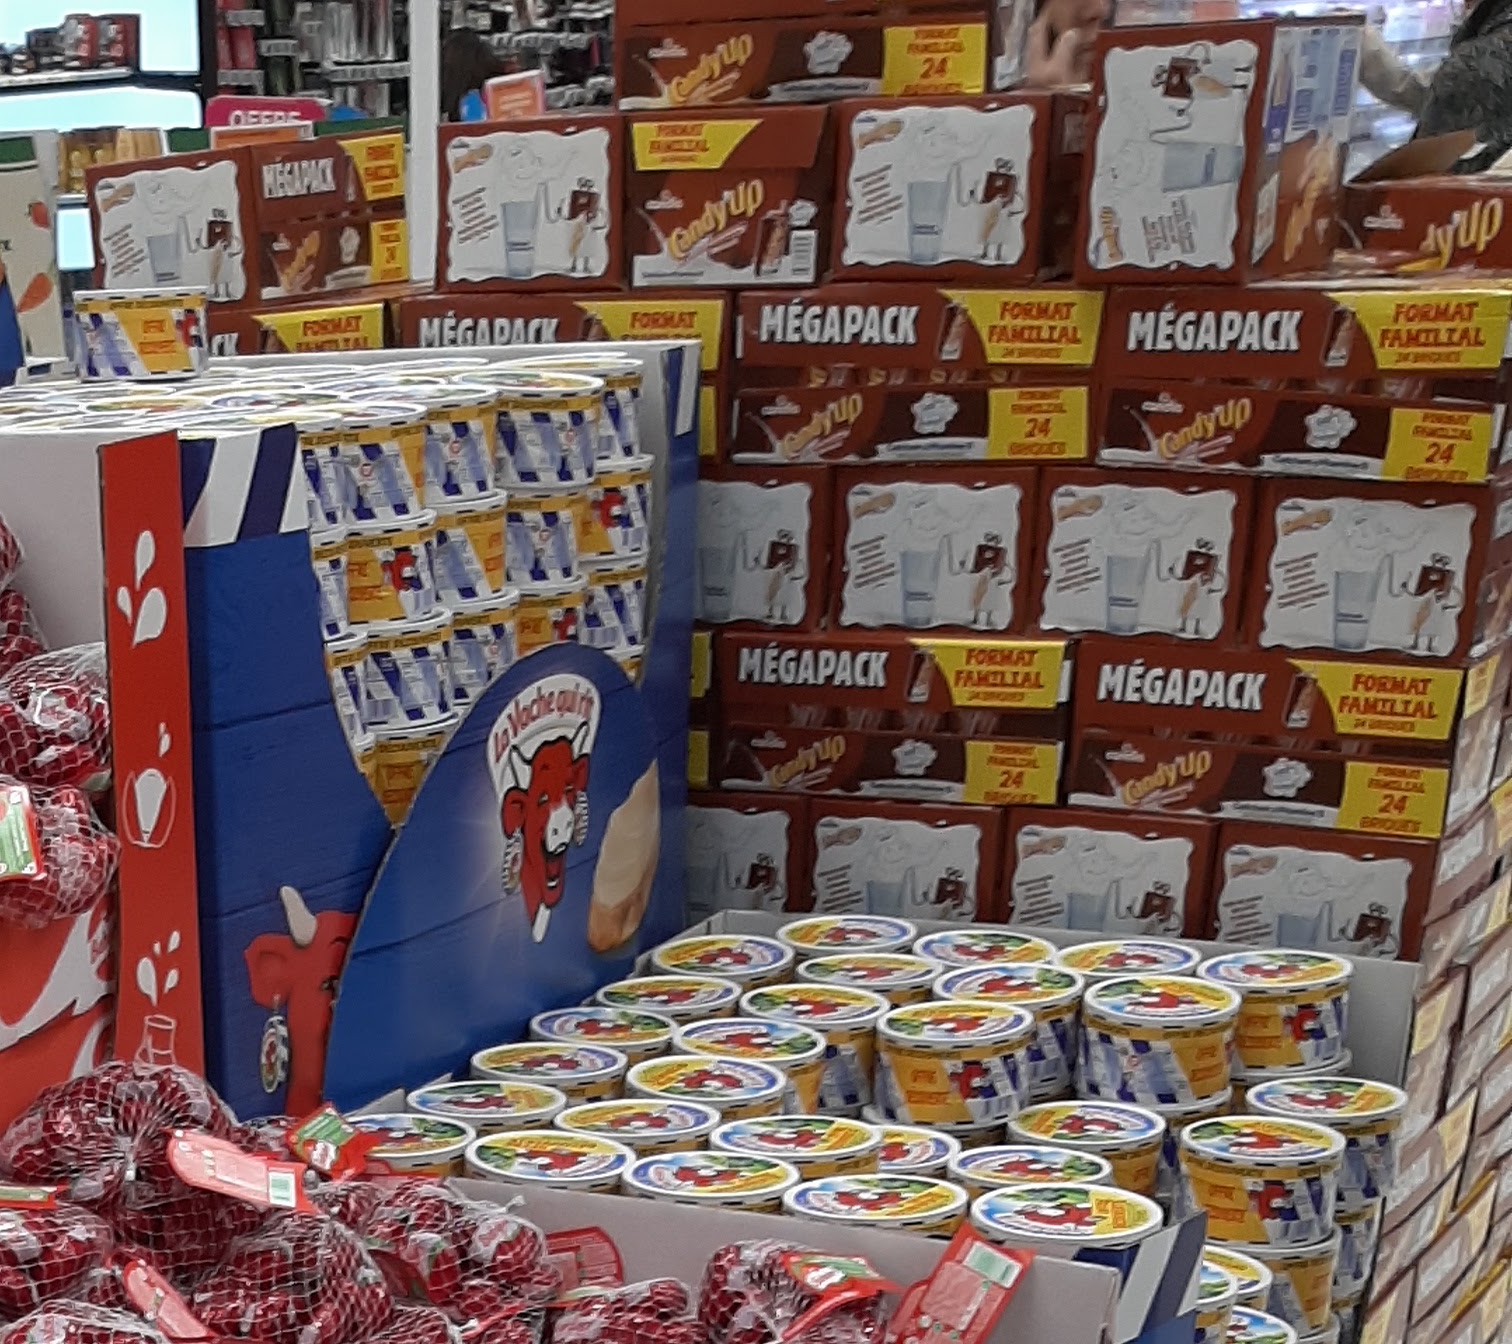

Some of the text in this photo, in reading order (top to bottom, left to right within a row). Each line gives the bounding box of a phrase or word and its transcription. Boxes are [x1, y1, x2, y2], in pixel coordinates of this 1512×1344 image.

[919, 57, 949, 79] 24
[759, 297, 920, 345] MÉGAPACK
[999, 301, 1077, 321] FORMAT
[1393, 302, 1480, 324] FORMAT
[988, 325, 1082, 346] FAMILIAL
[1127, 300, 1304, 352] MÉGAPACK
[1378, 327, 1486, 349] FAMILIAL
[1024, 418, 1051, 438] 24
[1424, 443, 1457, 464] 24
[738, 641, 889, 688] MÉGAPACK
[1097, 659, 1268, 712] MÉGAPACK
[1352, 672, 1433, 696] FORMAT
[1338, 696, 1439, 719] FAMILIAL
[998, 770, 1025, 789] 24
[1377, 794, 1408, 814] 24
